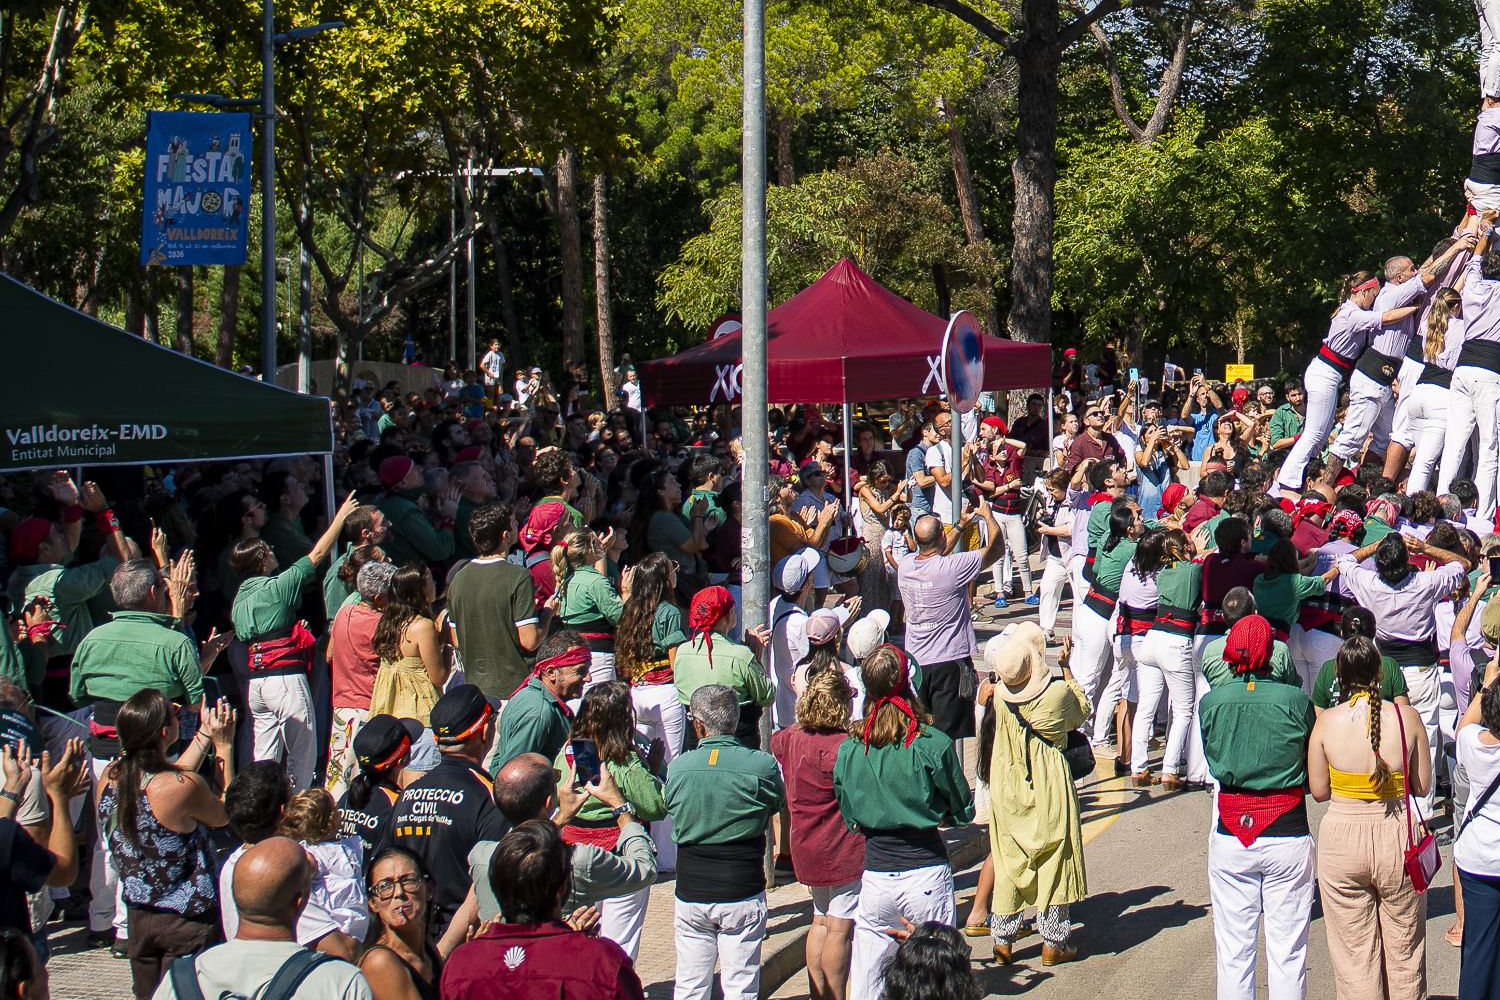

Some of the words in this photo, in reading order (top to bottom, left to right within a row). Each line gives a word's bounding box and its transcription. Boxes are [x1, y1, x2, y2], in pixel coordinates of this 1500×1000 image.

[158, 185, 240, 217] MAJOR
[6, 424, 168, 446] Valldoreix-EMD
[12, 448, 54, 461] Entitat
[57, 443, 116, 457] Municipal
[402, 788, 464, 805] PROTECCIÓ
[412, 801, 438, 814] CIVIL
[337, 808, 379, 829] OTECCIÓ
